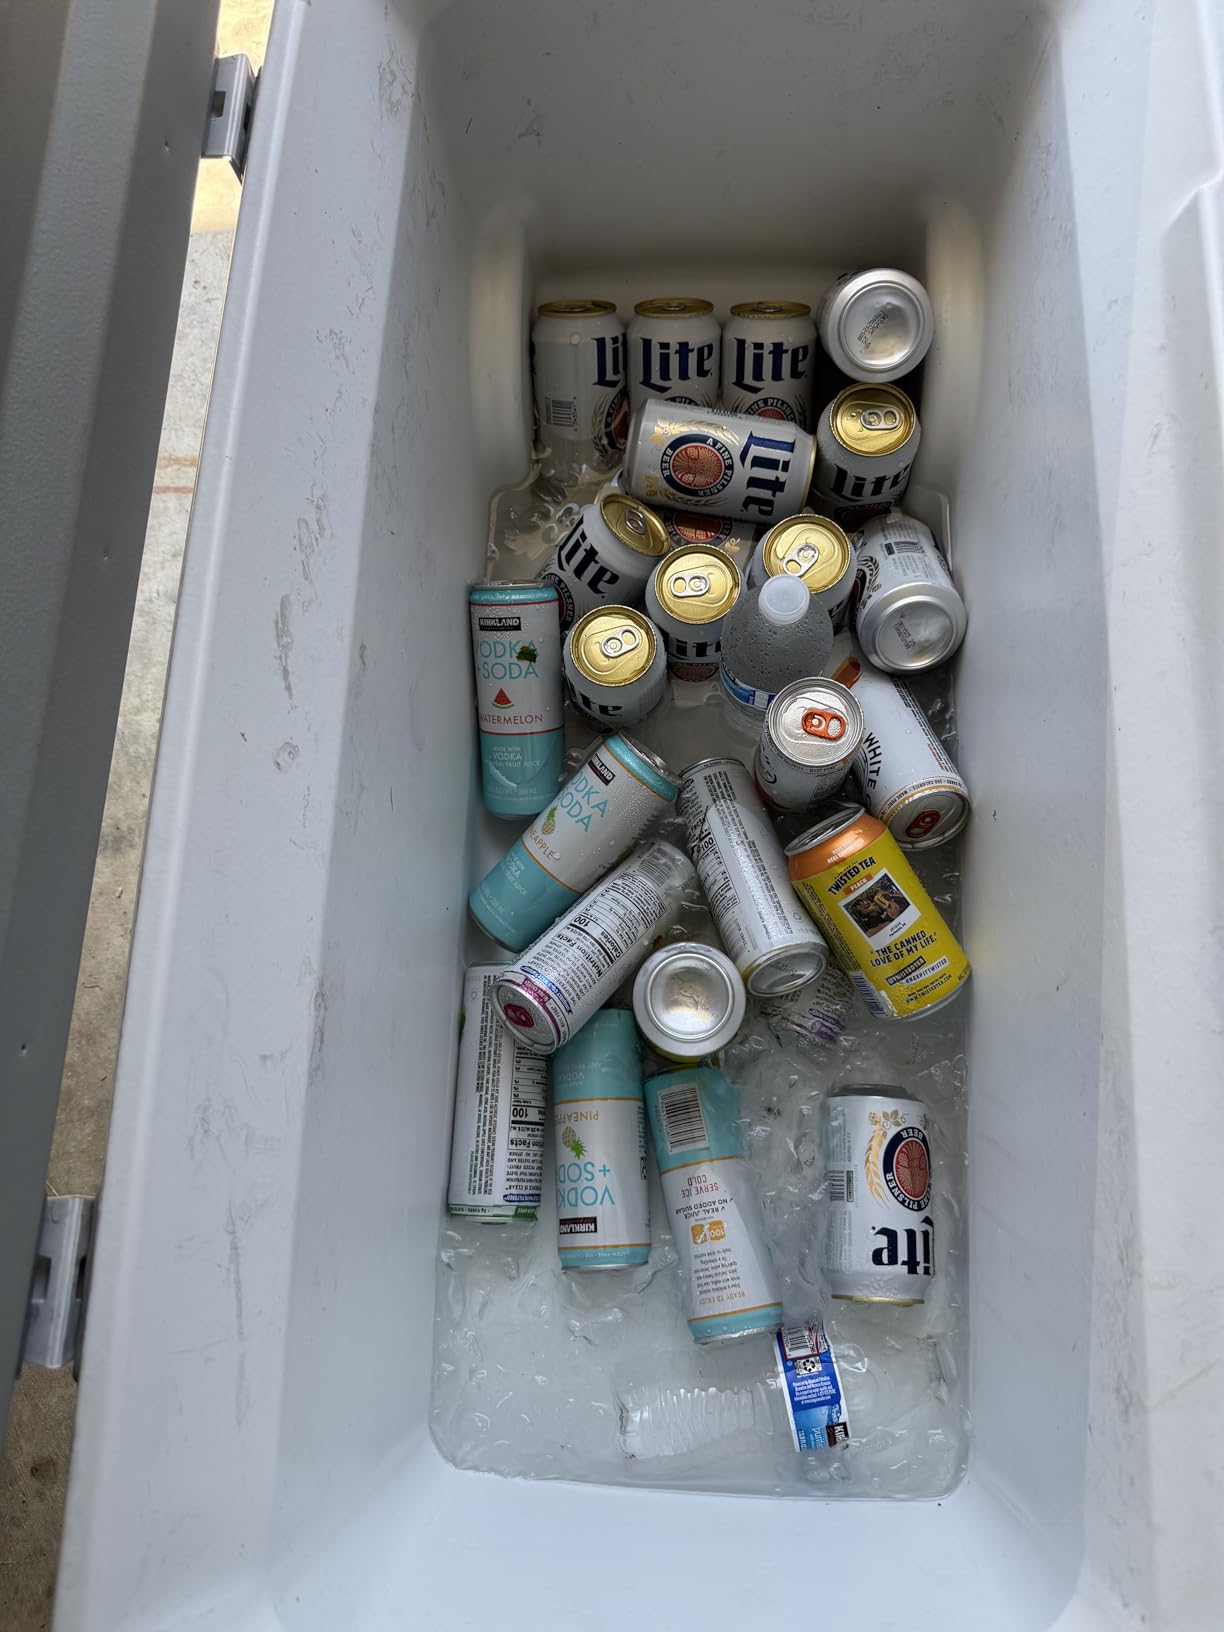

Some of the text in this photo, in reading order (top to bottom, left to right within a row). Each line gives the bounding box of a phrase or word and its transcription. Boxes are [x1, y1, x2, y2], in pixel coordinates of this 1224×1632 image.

[592, 332, 626, 388] Li
[639, 337, 714, 394] Lite
[731, 337, 810, 394] Lite
[767, 398, 795, 421] PILSNE
[661, 448, 673, 477] BEER
[706, 438, 733, 466] A FINE
[698, 467, 733, 497] PILSNER
[740, 431, 796, 517] Lite
[557, 515, 620, 599] Lite
[479, 617, 520, 626] KIRKLAND
[658, 625, 721, 661] Lit
[493, 752, 522, 760] VODKA
[863, 732, 883, 790] WHITE
[699, 836, 714, 851] 100
[827, 855, 877, 895] TWISTED TEA
[849, 877, 867, 891] PEACH
[573, 916, 621, 958] Calories 100
[893, 929, 926, 951] CANNED
[556, 933, 603, 977] Nutrition Facts
[869, 954, 892, 966] LOVE
[892, 949, 905, 961] OF
[905, 943, 919, 955] MY
[511, 1107, 528, 1118] 100
[509, 1138, 530, 1148] Facts
[900, 1130, 924, 1140] BEER
[558, 1161, 594, 1182] SOD
[686, 1174, 707, 1186] COLD
[558, 1184, 615, 1208] VODK
[680, 1182, 718, 1198] SERVE ICE
[885, 1171, 919, 1211] PILSNER
[675, 1205, 692, 1214] SUGAR
[683, 1206, 719, 1219] REAL JUICE
[693, 1199, 716, 1209] ADDED
